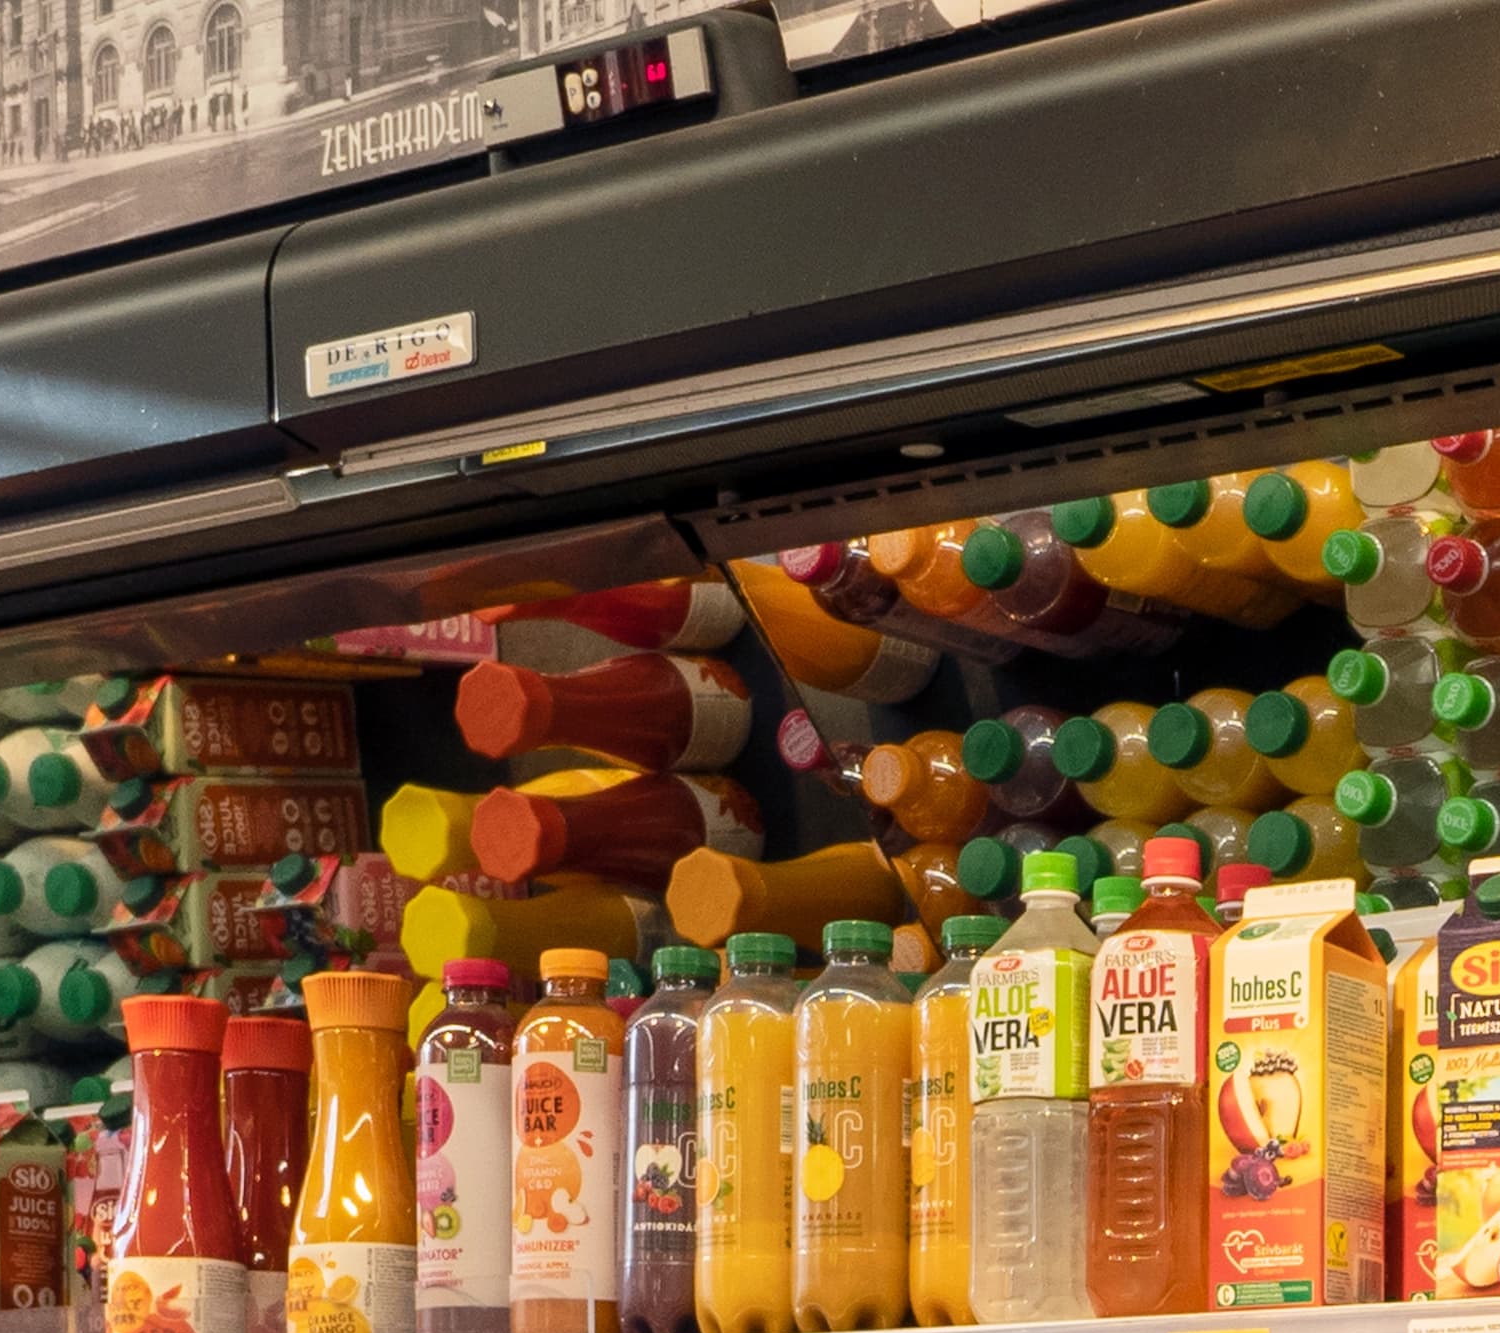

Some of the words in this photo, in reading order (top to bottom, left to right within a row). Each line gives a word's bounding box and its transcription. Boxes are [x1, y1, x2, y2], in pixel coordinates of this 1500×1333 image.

[326, 345, 357, 366] DE
[375, 322, 451, 358] RIGO
[1102, 961, 1177, 1001] ALOE
[1231, 976, 1286, 1003] hohes
[1290, 970, 1302, 998] C
[975, 982, 1039, 1019] ALOE
[1096, 999, 1177, 1038] VERA
[1251, 1017, 1280, 1031] Plus
[973, 1019, 1041, 1055] VERA
[523, 1115, 558, 1135] BAR
[13, 1167, 54, 1193] Sió
[9, 1197, 57, 1217] JUICE
